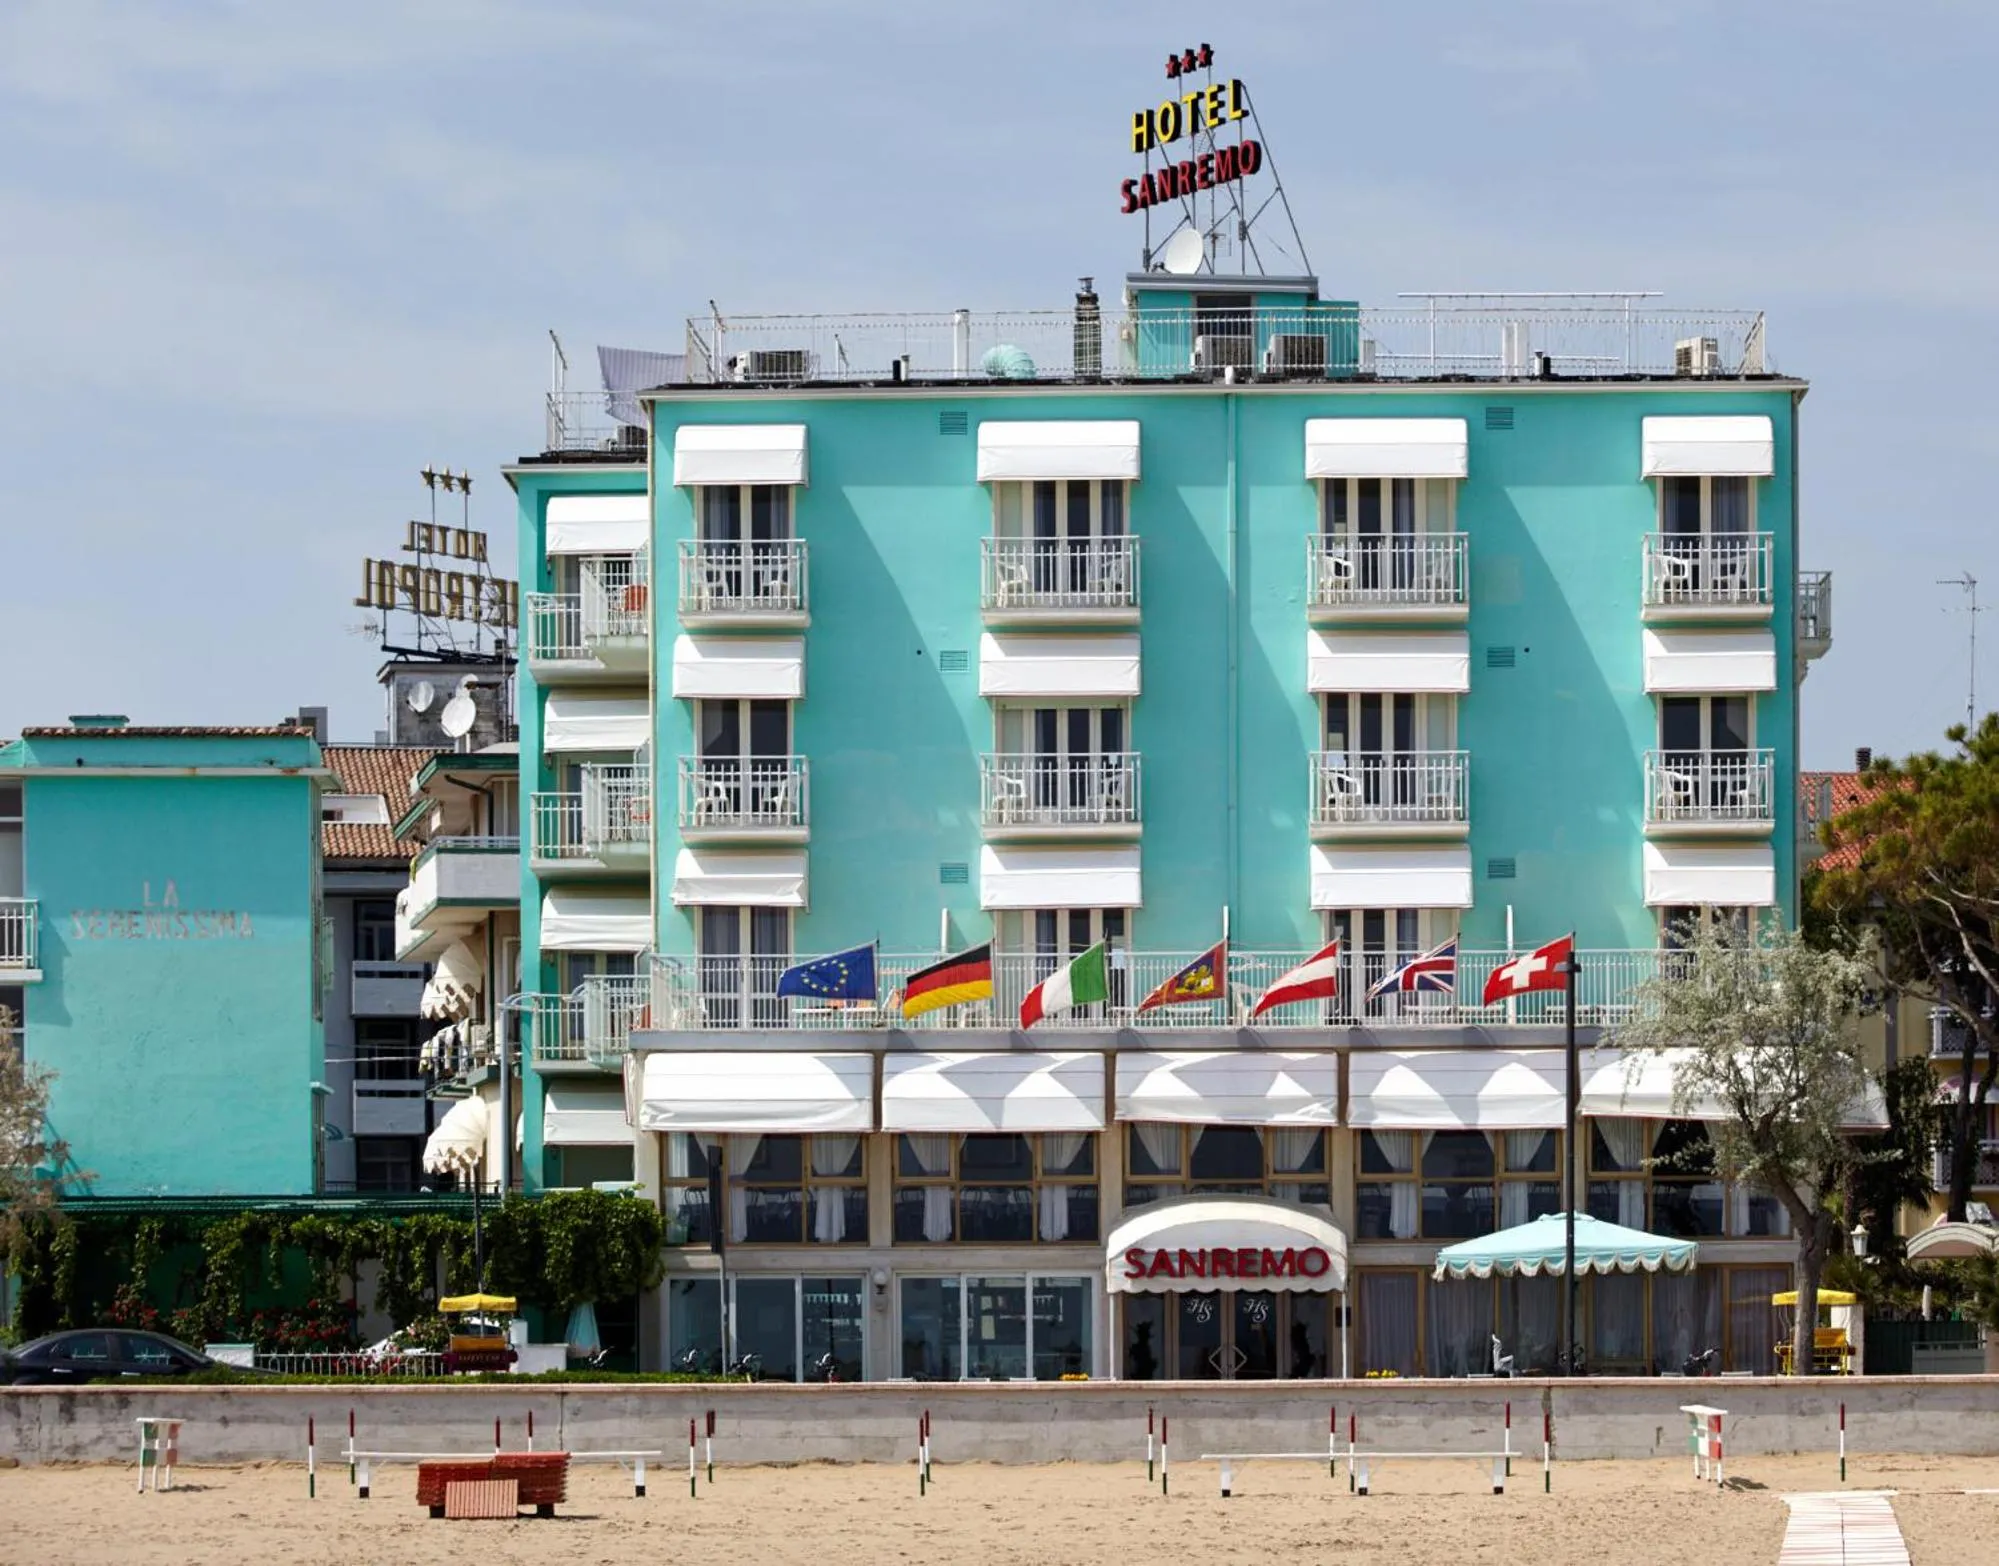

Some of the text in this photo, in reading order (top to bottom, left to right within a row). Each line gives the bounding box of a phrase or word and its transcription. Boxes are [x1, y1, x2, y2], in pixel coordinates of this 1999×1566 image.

[1131, 79, 1250, 153] HOTEL
[1120, 139, 1263, 214] SANREMO
[143, 879, 179, 908] LA
[70, 910, 255, 940] SERENISSIMA
[1124, 1246, 1331, 1279] SANREMO
